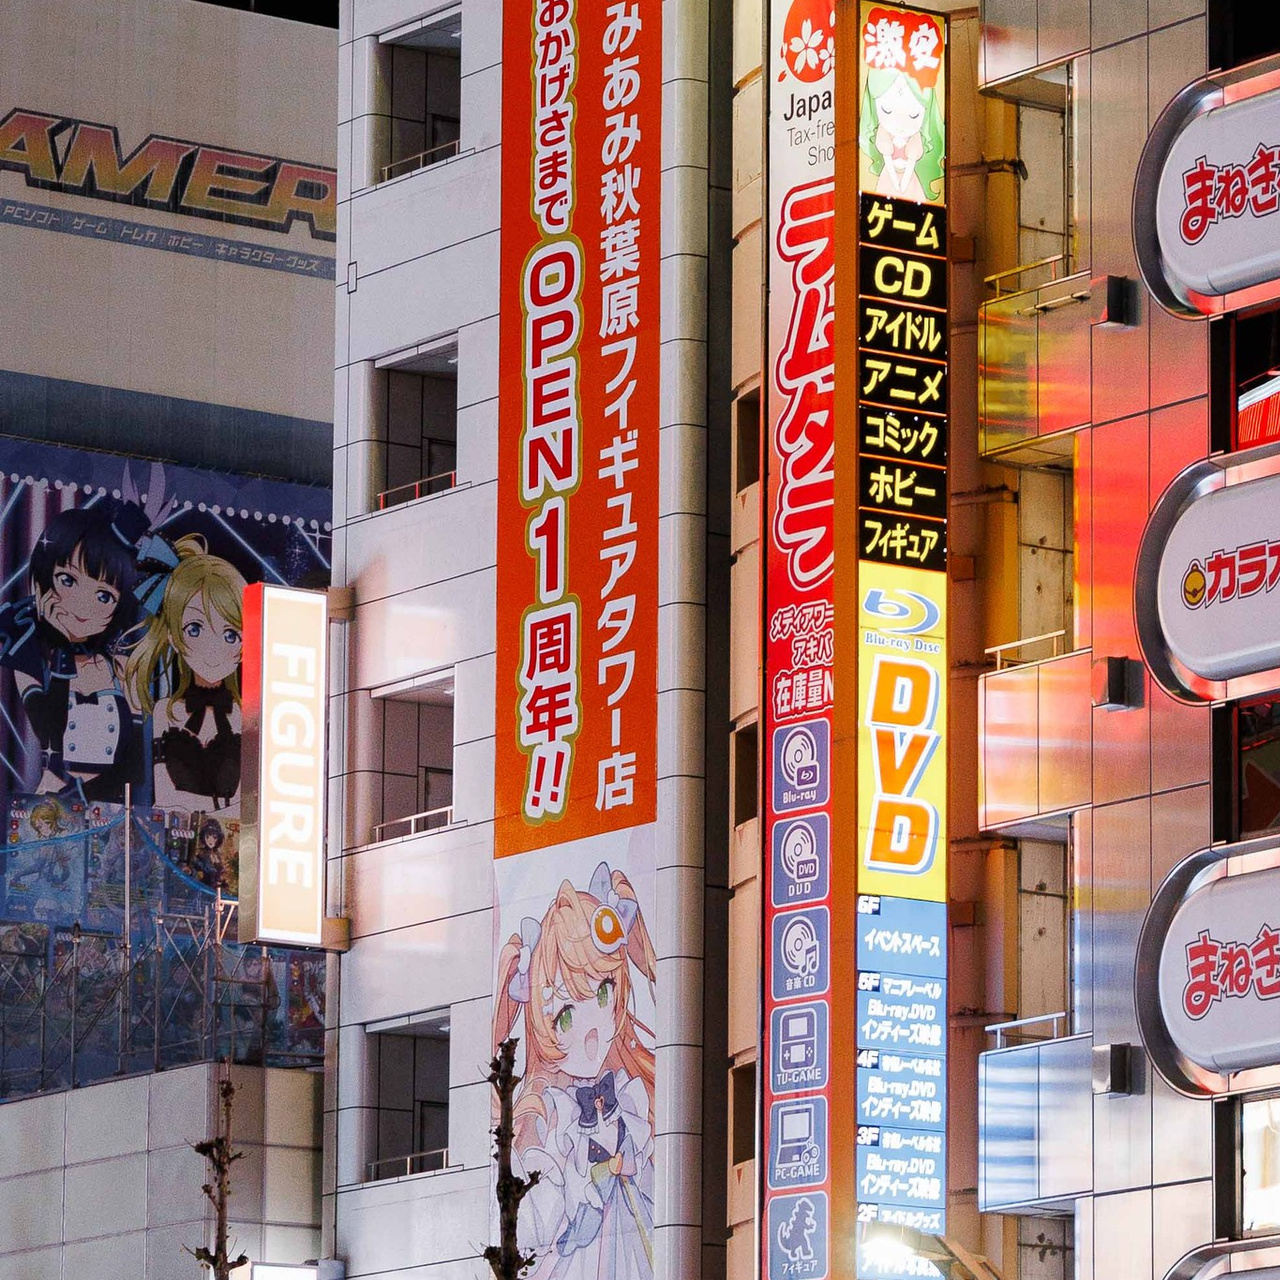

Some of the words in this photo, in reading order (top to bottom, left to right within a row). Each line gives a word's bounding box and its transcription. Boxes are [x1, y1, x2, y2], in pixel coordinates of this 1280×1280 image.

[864, 17, 941, 71] 激安
[783, 90, 834, 122] Japa
[786, 122, 834, 148] Tax-fre
[807, 143, 835, 167] Sho
[867, 203, 940, 250] ゲーム
[873, 255, 931, 298] CD
[863, 308, 942, 353] アイドル
[862, 359, 944, 404] アニメ
[865, 416, 938, 458] コミック
[868, 466, 937, 507] ホビー
[864, 519, 939, 563] フィギュア
[865, 631, 911, 652] Blu-ray
[270, 642, 316, 890] FIGURE
[865, 655, 942, 875] DVD
[782, 789, 817, 804] Blu-ray
[798, 861, 815, 876] DVD
[857, 1127, 880, 1146] 3F
